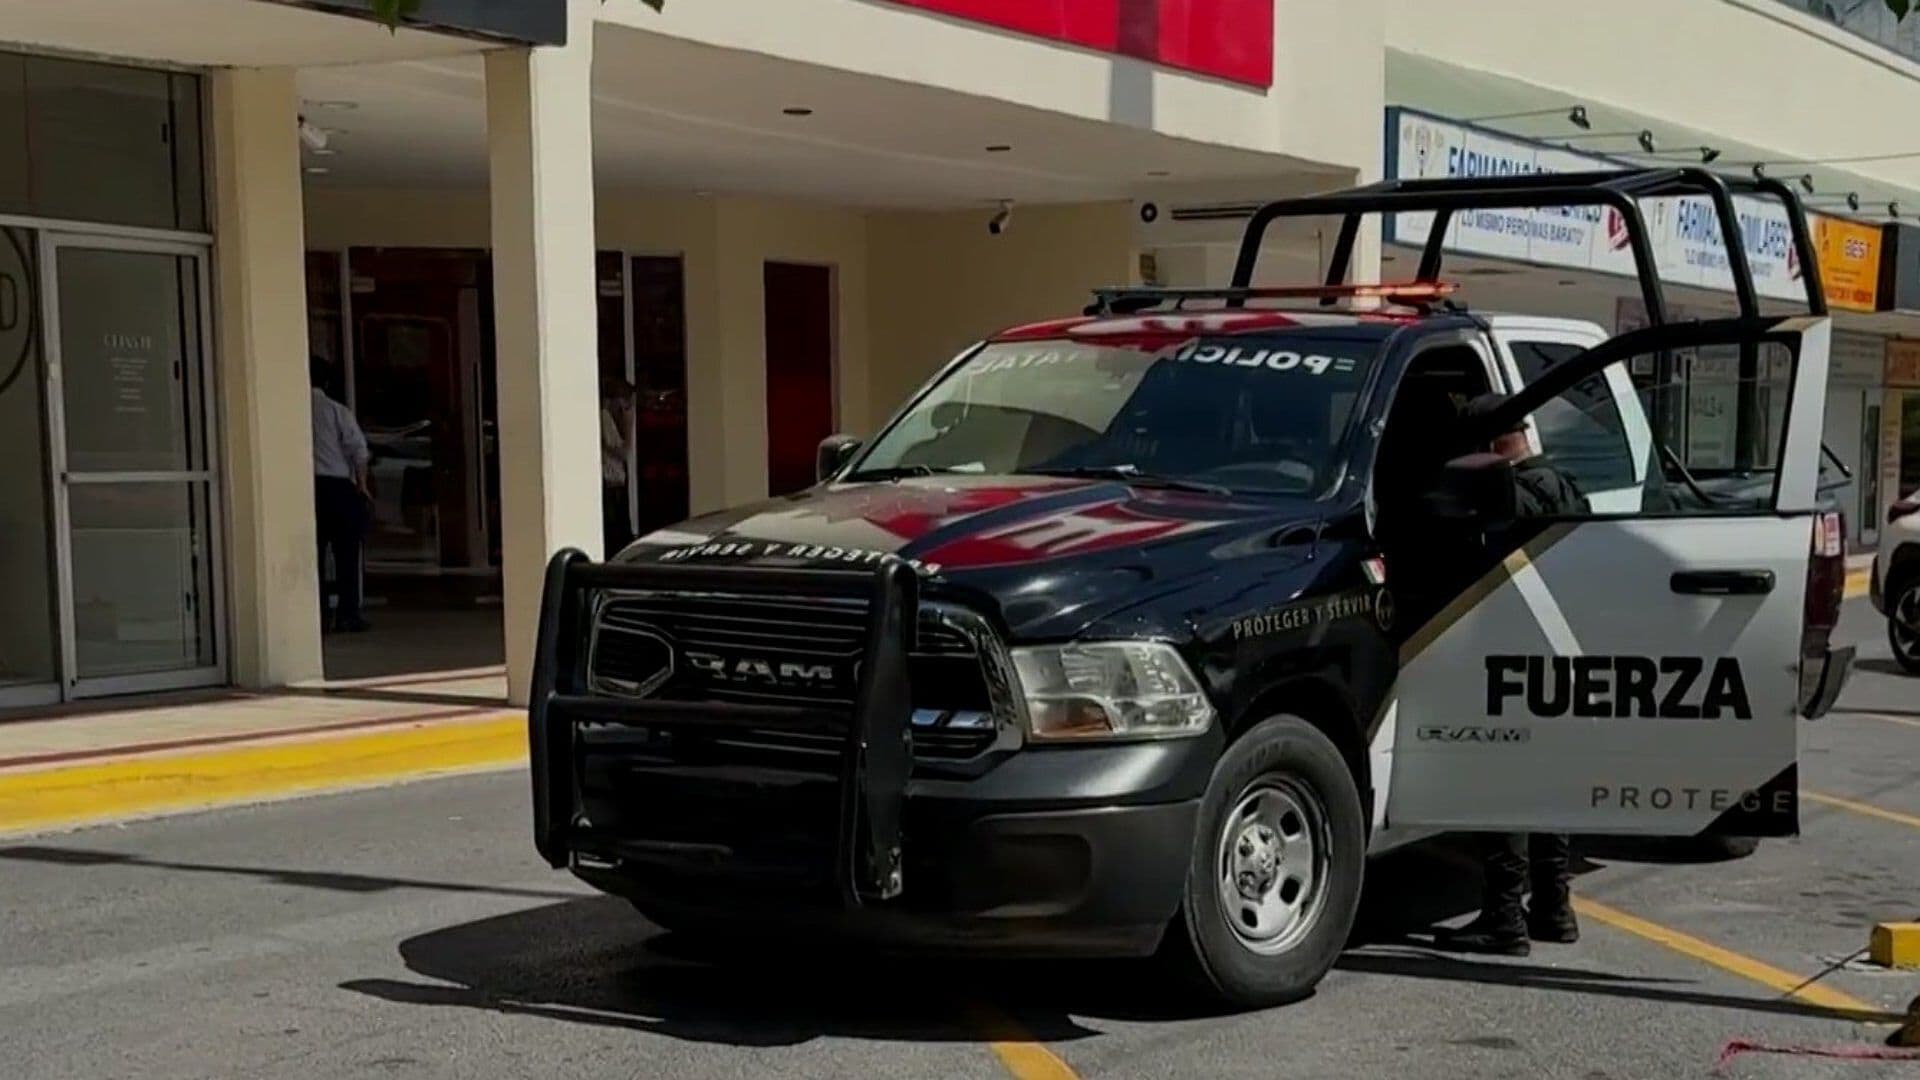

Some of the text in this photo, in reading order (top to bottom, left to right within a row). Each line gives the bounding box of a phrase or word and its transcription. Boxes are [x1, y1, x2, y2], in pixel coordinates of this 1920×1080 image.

[1232, 594, 1371, 640] PROTEGER Y SERVIR
[685, 651, 834, 688] RAM
[1485, 655, 1752, 720] FUERZA
[1417, 725, 1530, 743] RAM
[1591, 786, 1792, 812] PROTEGE
